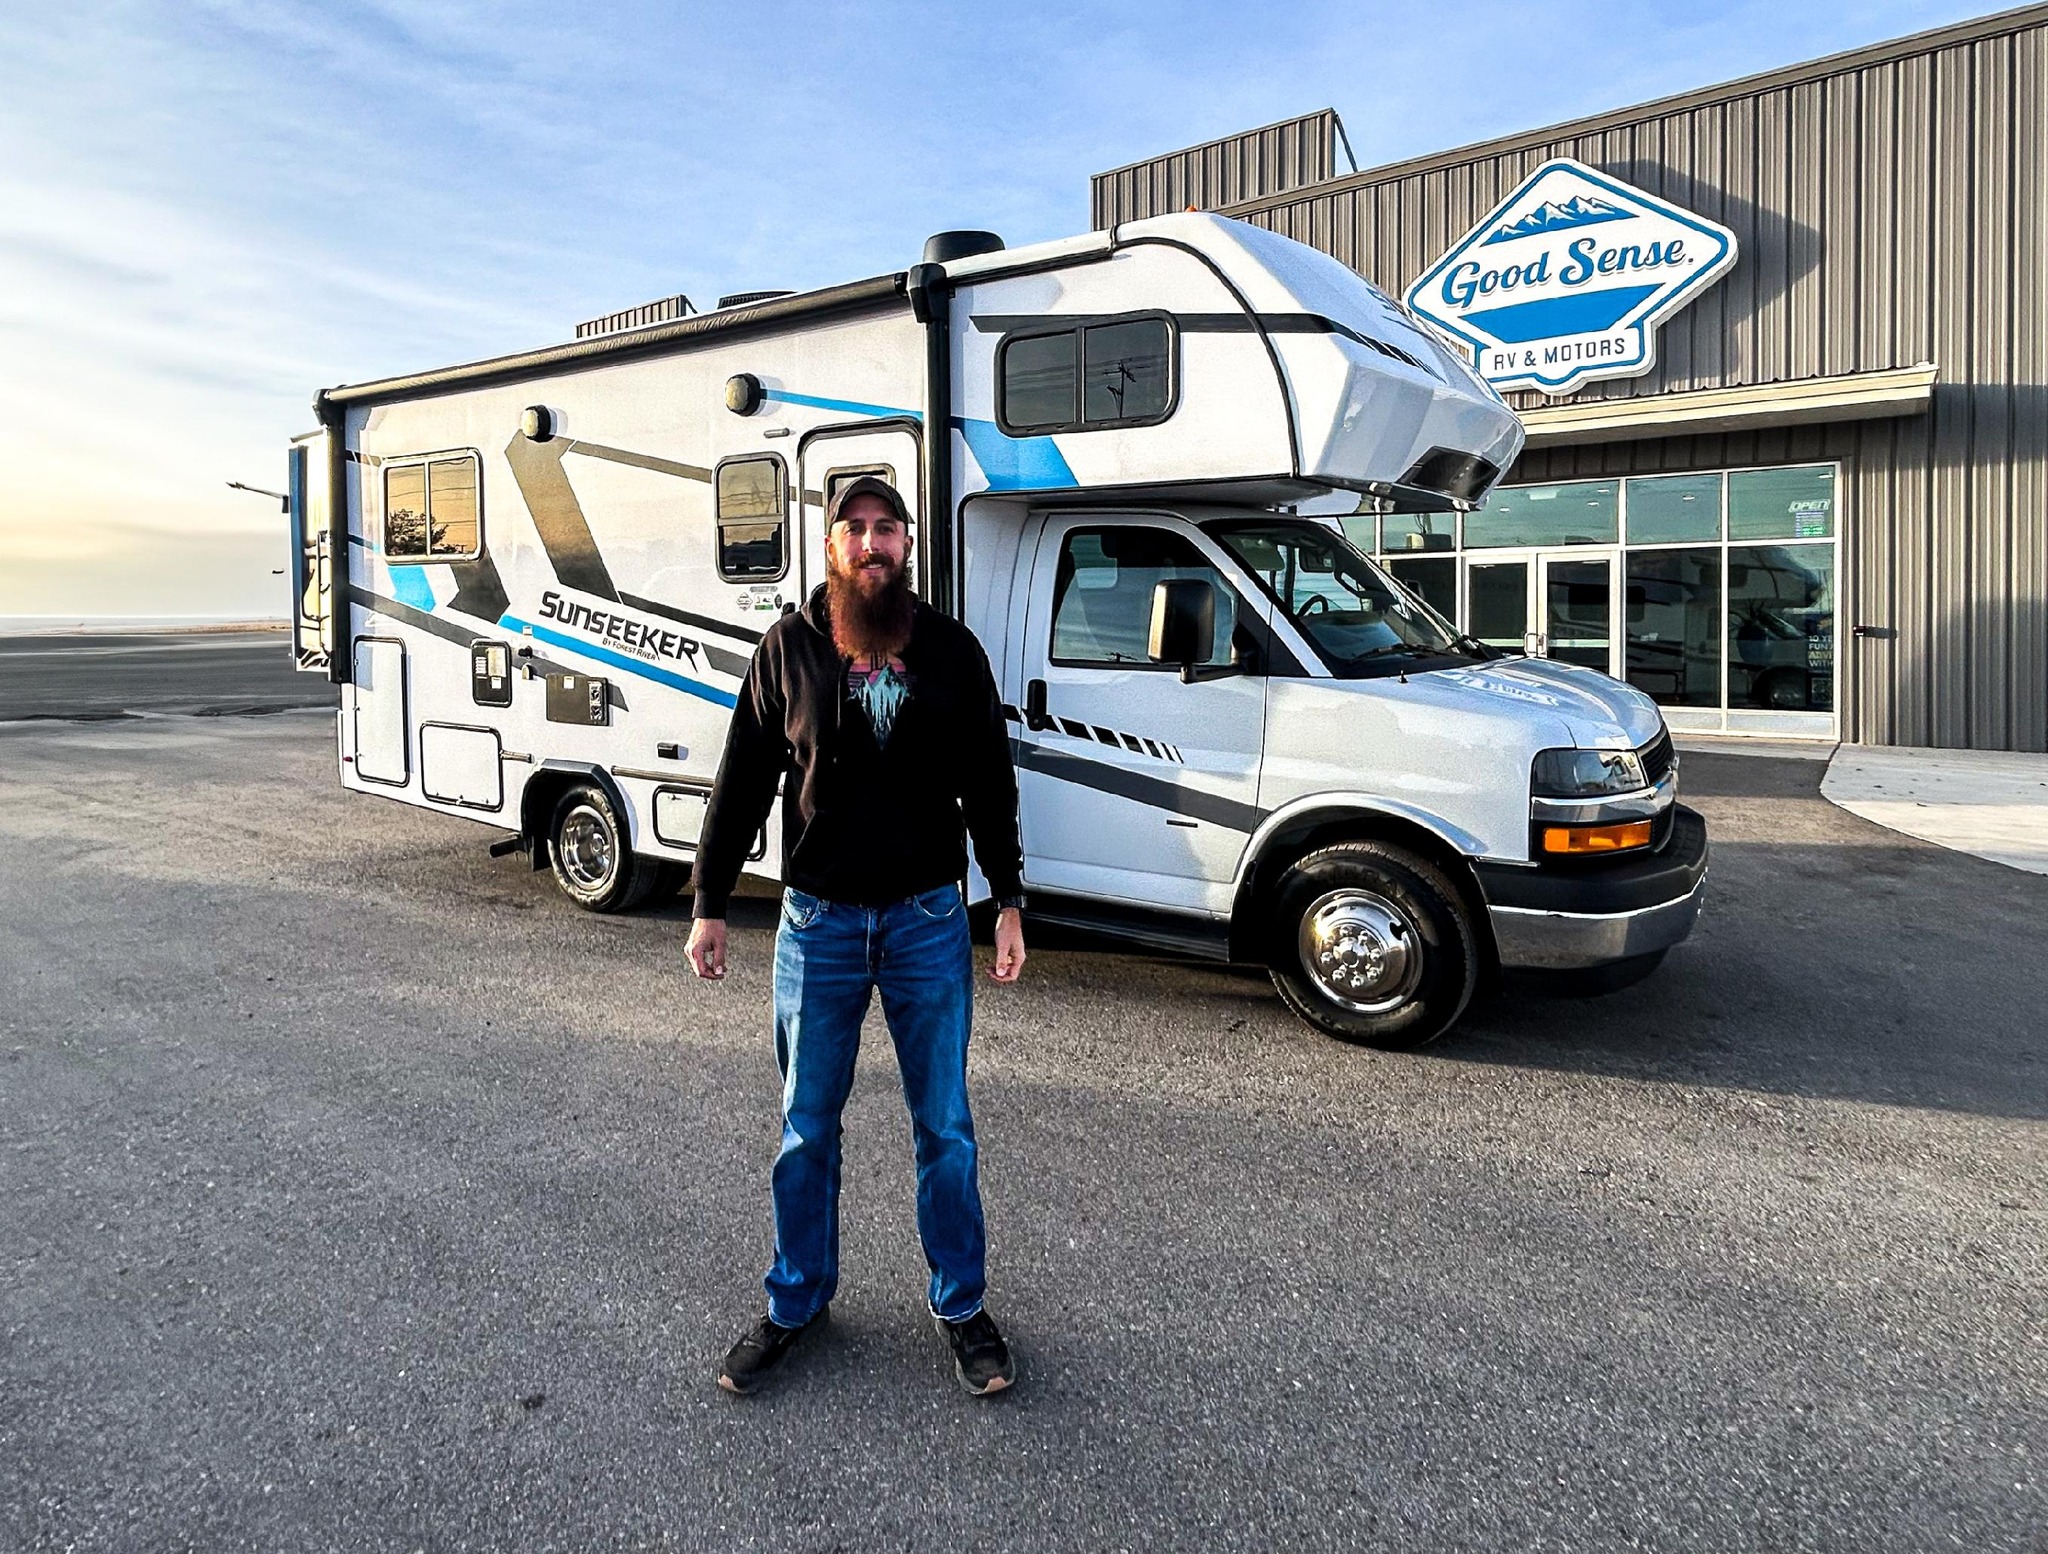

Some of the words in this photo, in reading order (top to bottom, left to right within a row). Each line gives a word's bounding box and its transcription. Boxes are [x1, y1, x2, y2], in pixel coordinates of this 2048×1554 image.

[1441, 251, 1552, 309] Good
[1559, 238, 1695, 286] Sense.
[1494, 352, 1516, 370] RV
[1524, 350, 1537, 367] &
[1544, 338, 1625, 364] MOTORS
[1792, 500, 1829, 511] OPEN
[539, 591, 699, 673] SUNSEEKER
